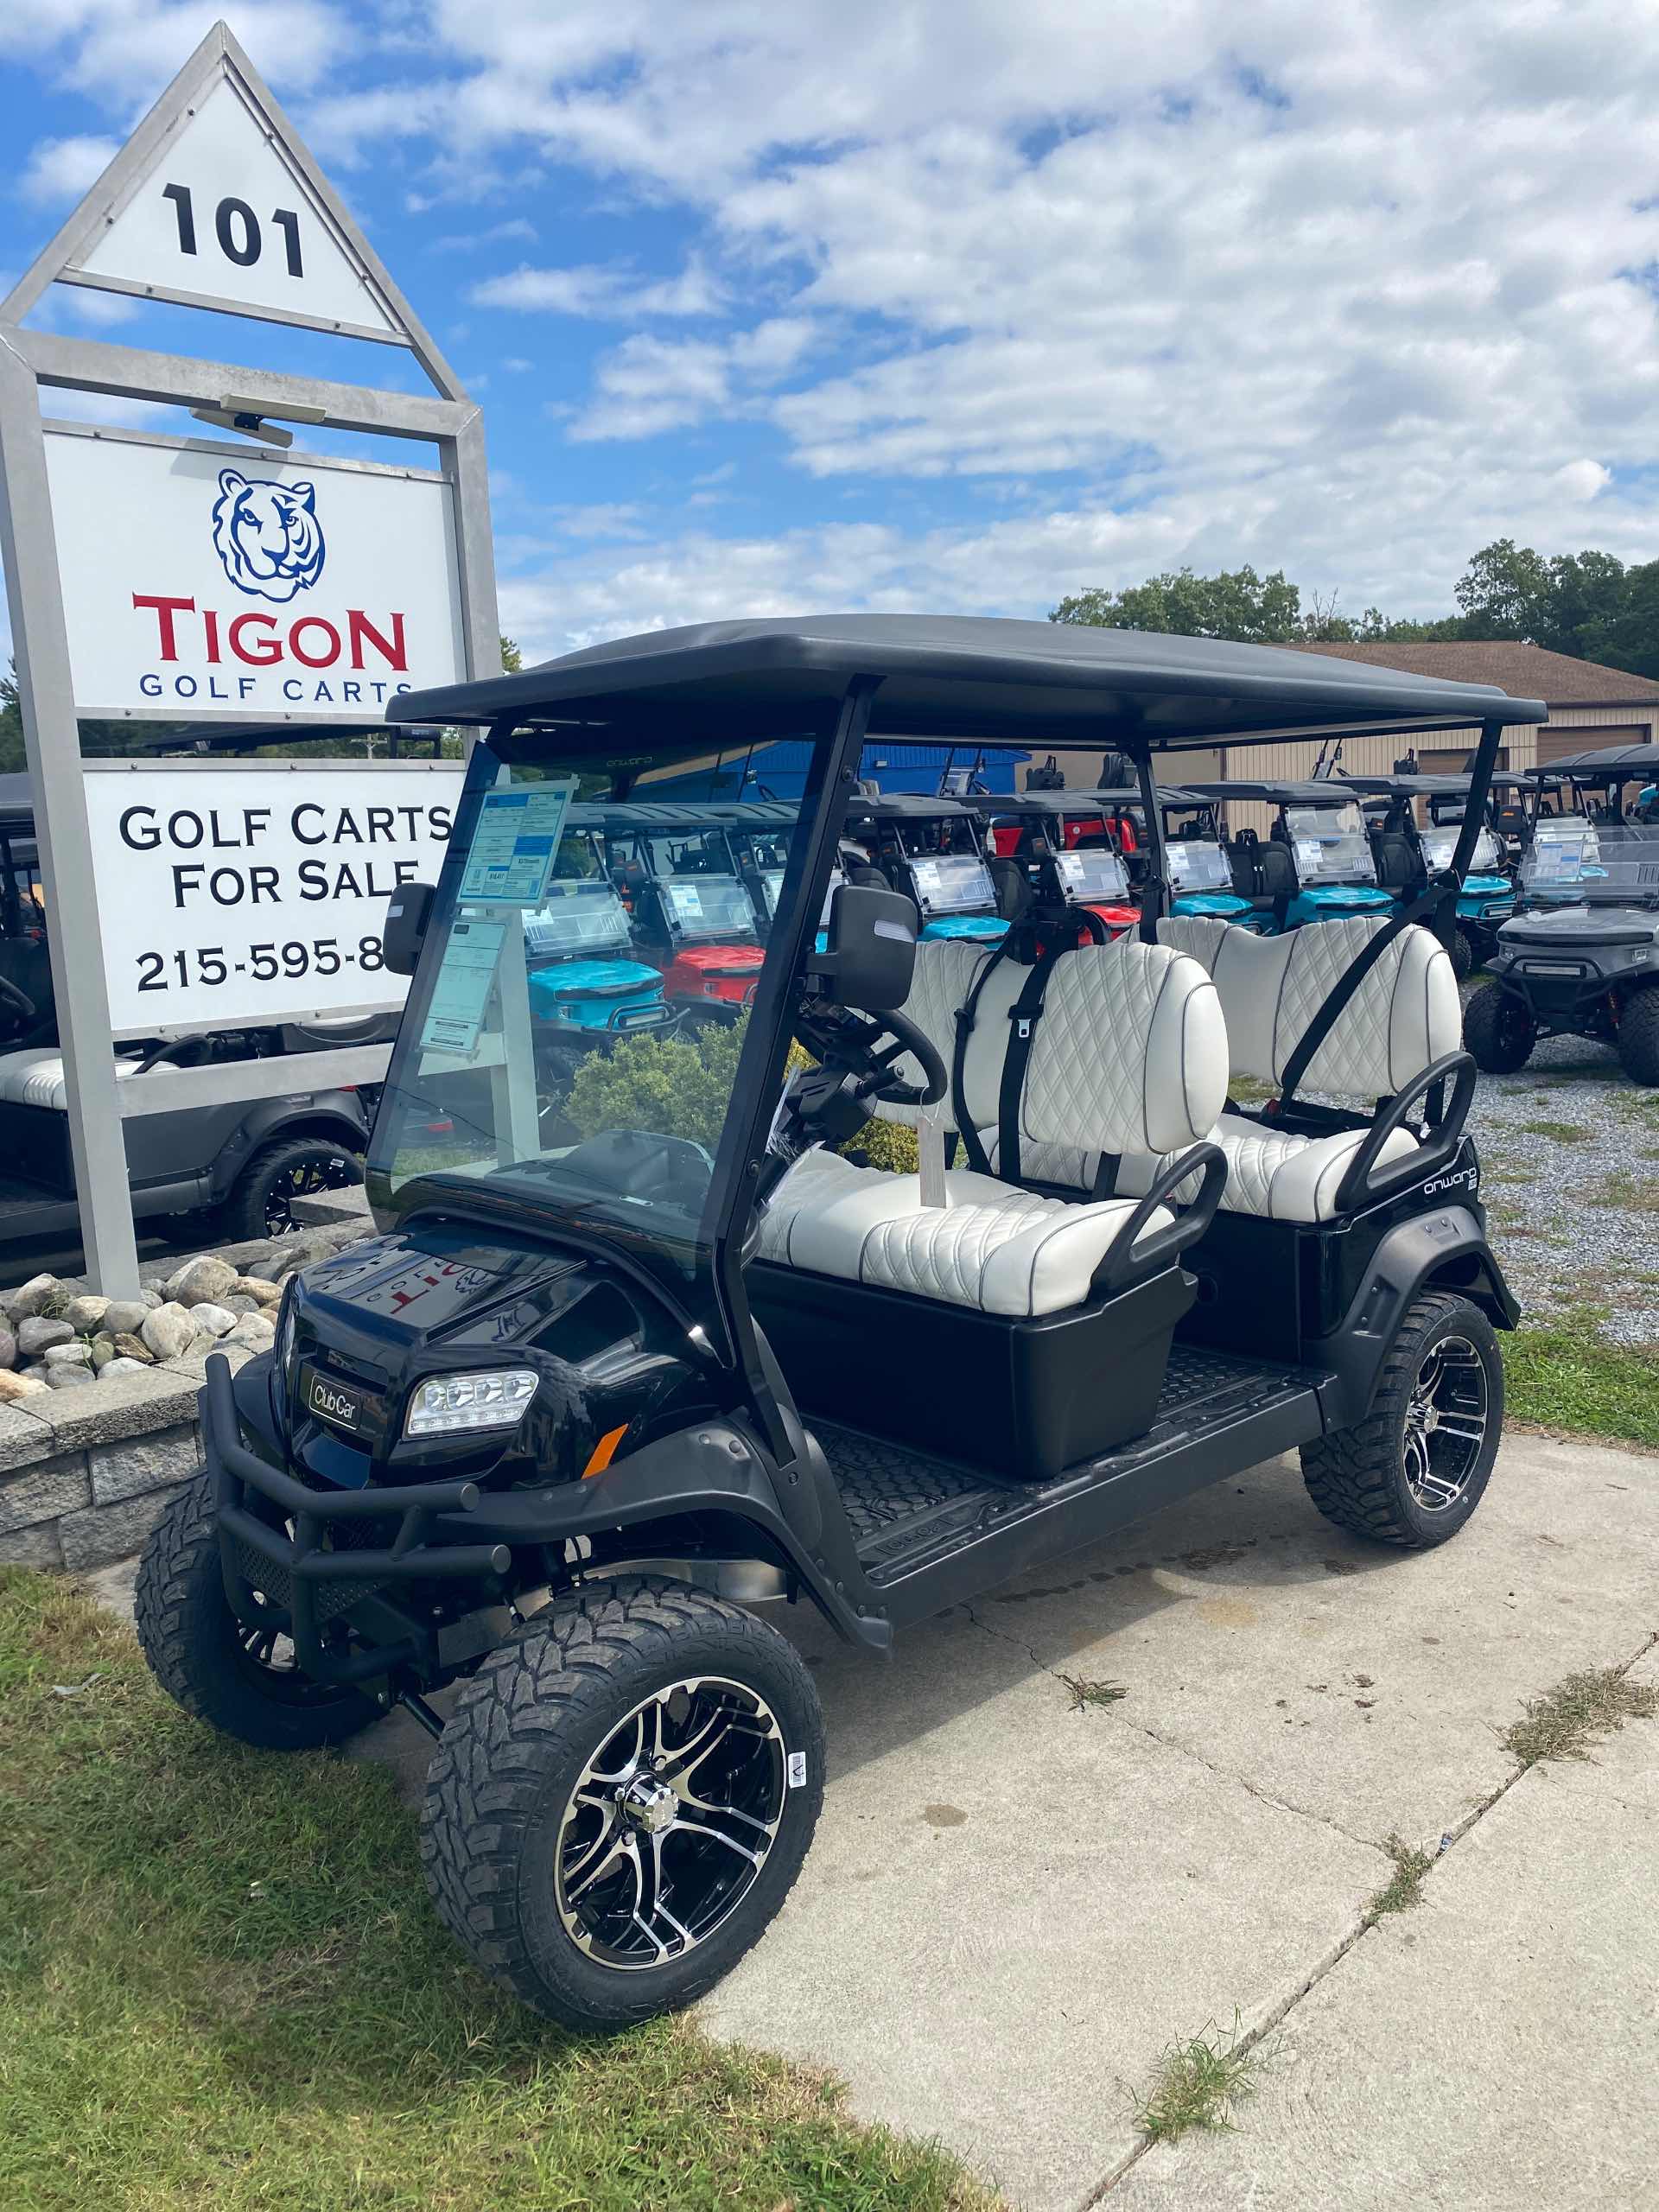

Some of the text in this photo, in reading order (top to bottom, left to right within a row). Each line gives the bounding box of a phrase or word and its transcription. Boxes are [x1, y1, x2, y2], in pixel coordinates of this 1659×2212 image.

[162, 182, 304, 279] 101
[132, 592, 410, 671] TIGON
[139, 673, 257, 699] GOLF
[119, 803, 450, 851] GOLF CARTS
[171, 858, 420, 908] FOR SALE
[135, 936, 385, 994] 215-595-8
